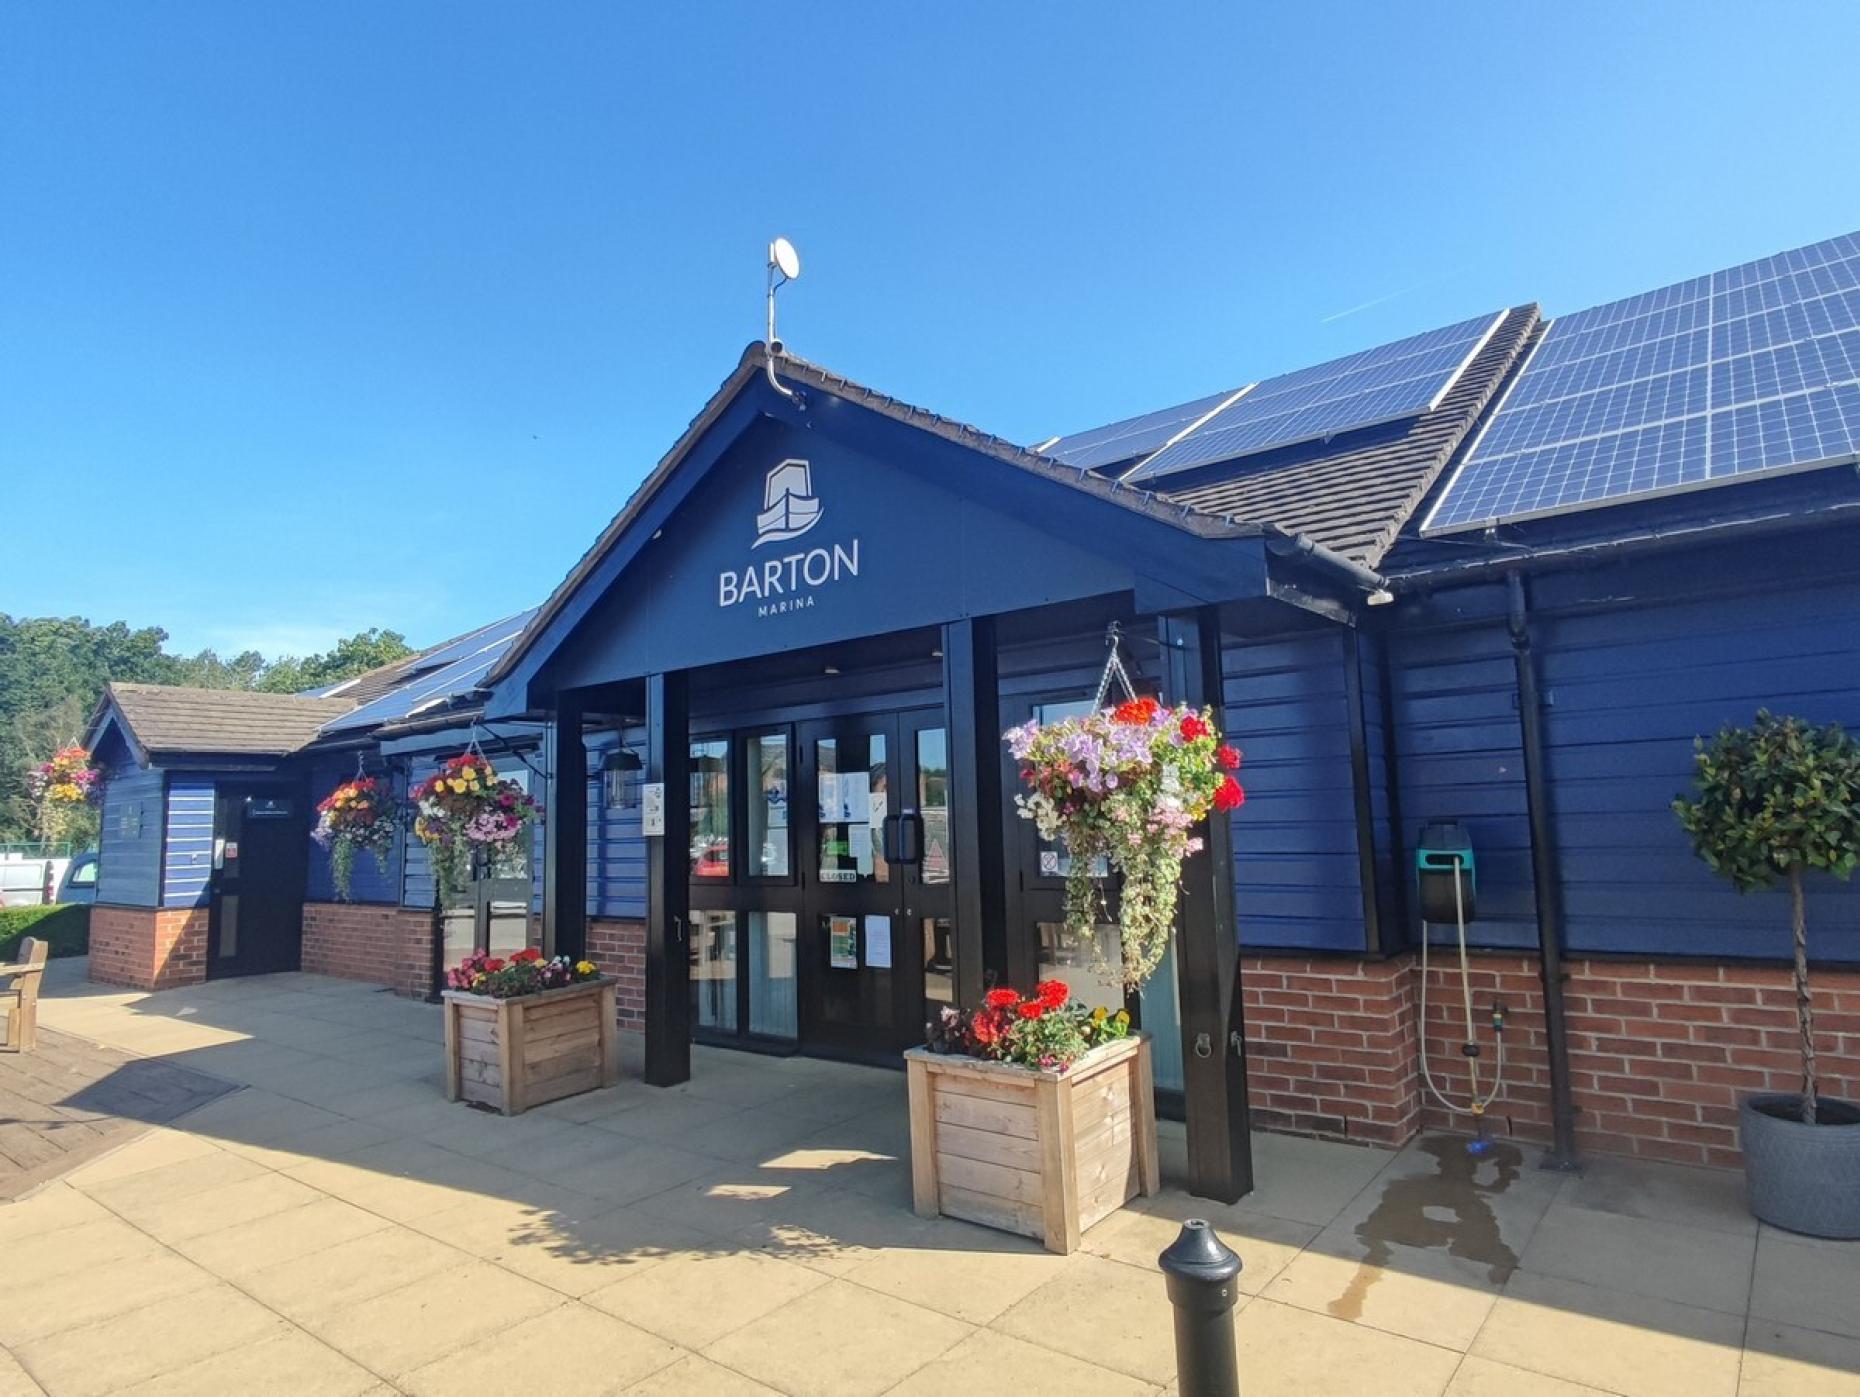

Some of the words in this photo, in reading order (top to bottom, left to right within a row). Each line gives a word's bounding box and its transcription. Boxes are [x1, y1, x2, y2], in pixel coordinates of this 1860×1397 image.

[719, 539, 859, 607] BARTON
[758, 595, 815, 617] MARINA
[821, 872, 856, 881] CLOSED
